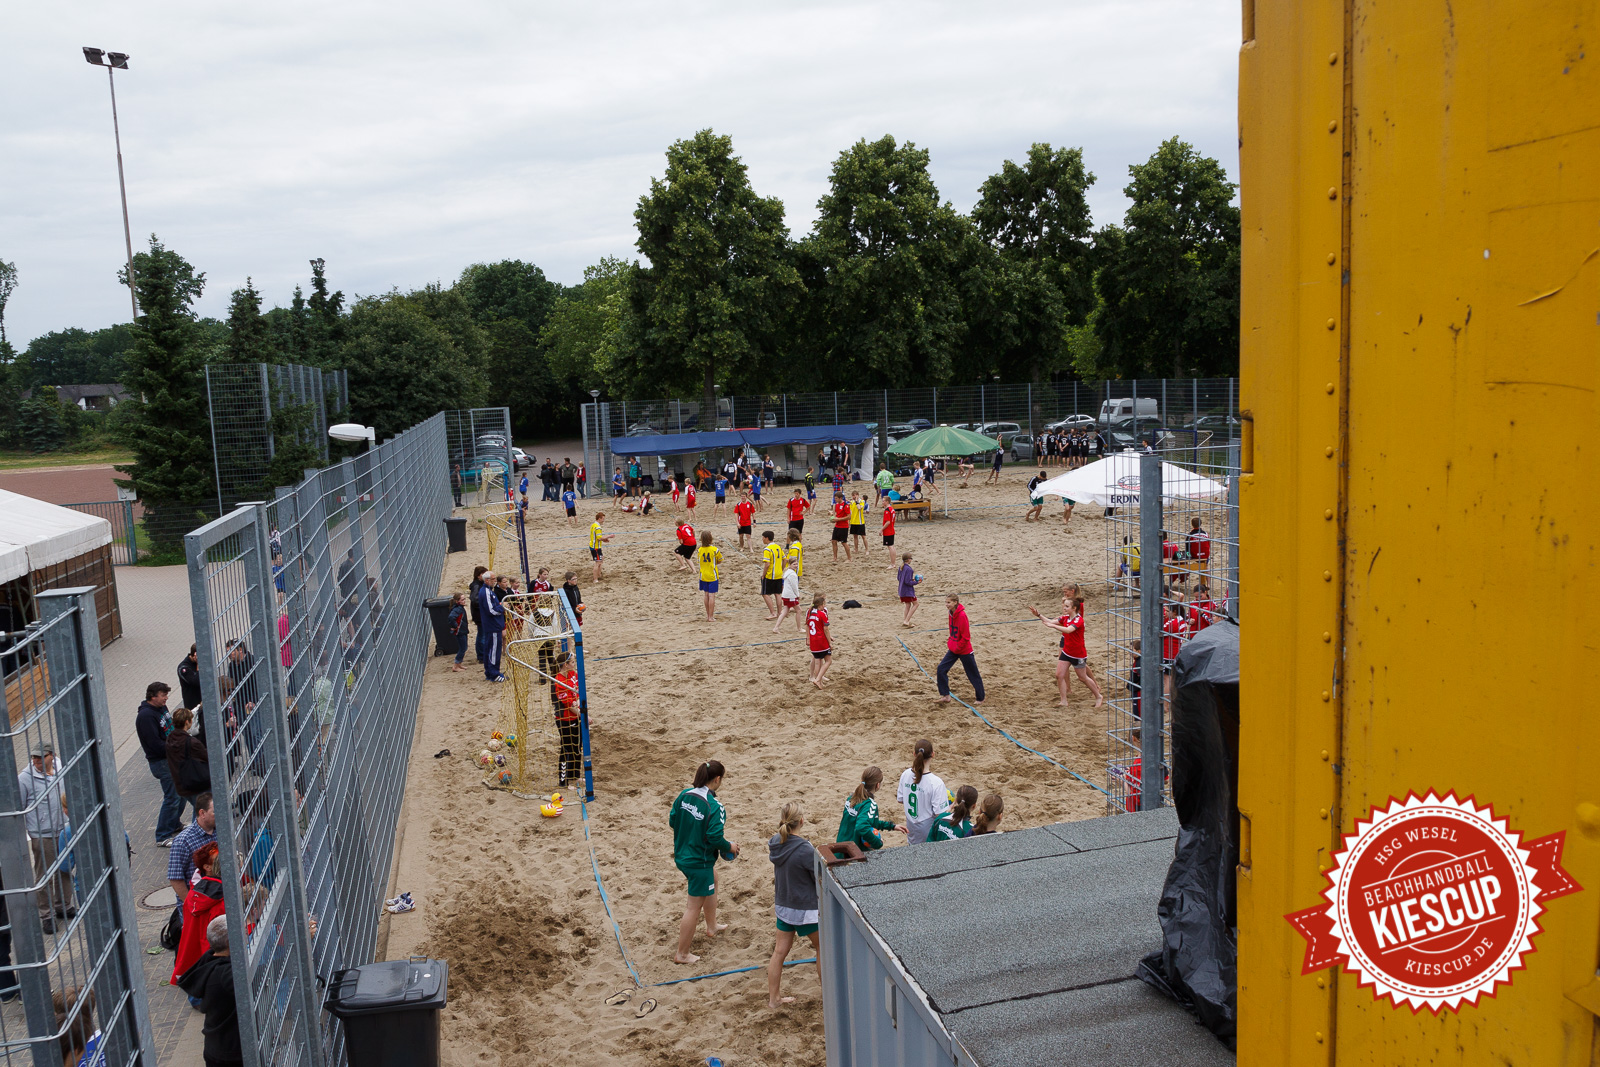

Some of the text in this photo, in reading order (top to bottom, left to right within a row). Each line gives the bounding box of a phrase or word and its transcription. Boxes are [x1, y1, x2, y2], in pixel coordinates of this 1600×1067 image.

[1110, 494, 1140, 505] ERDIN
[702, 552, 711, 562] 14
[776, 548, 780, 559] 1
[809, 620, 817, 636] 3
[907, 792, 918, 819] 9
